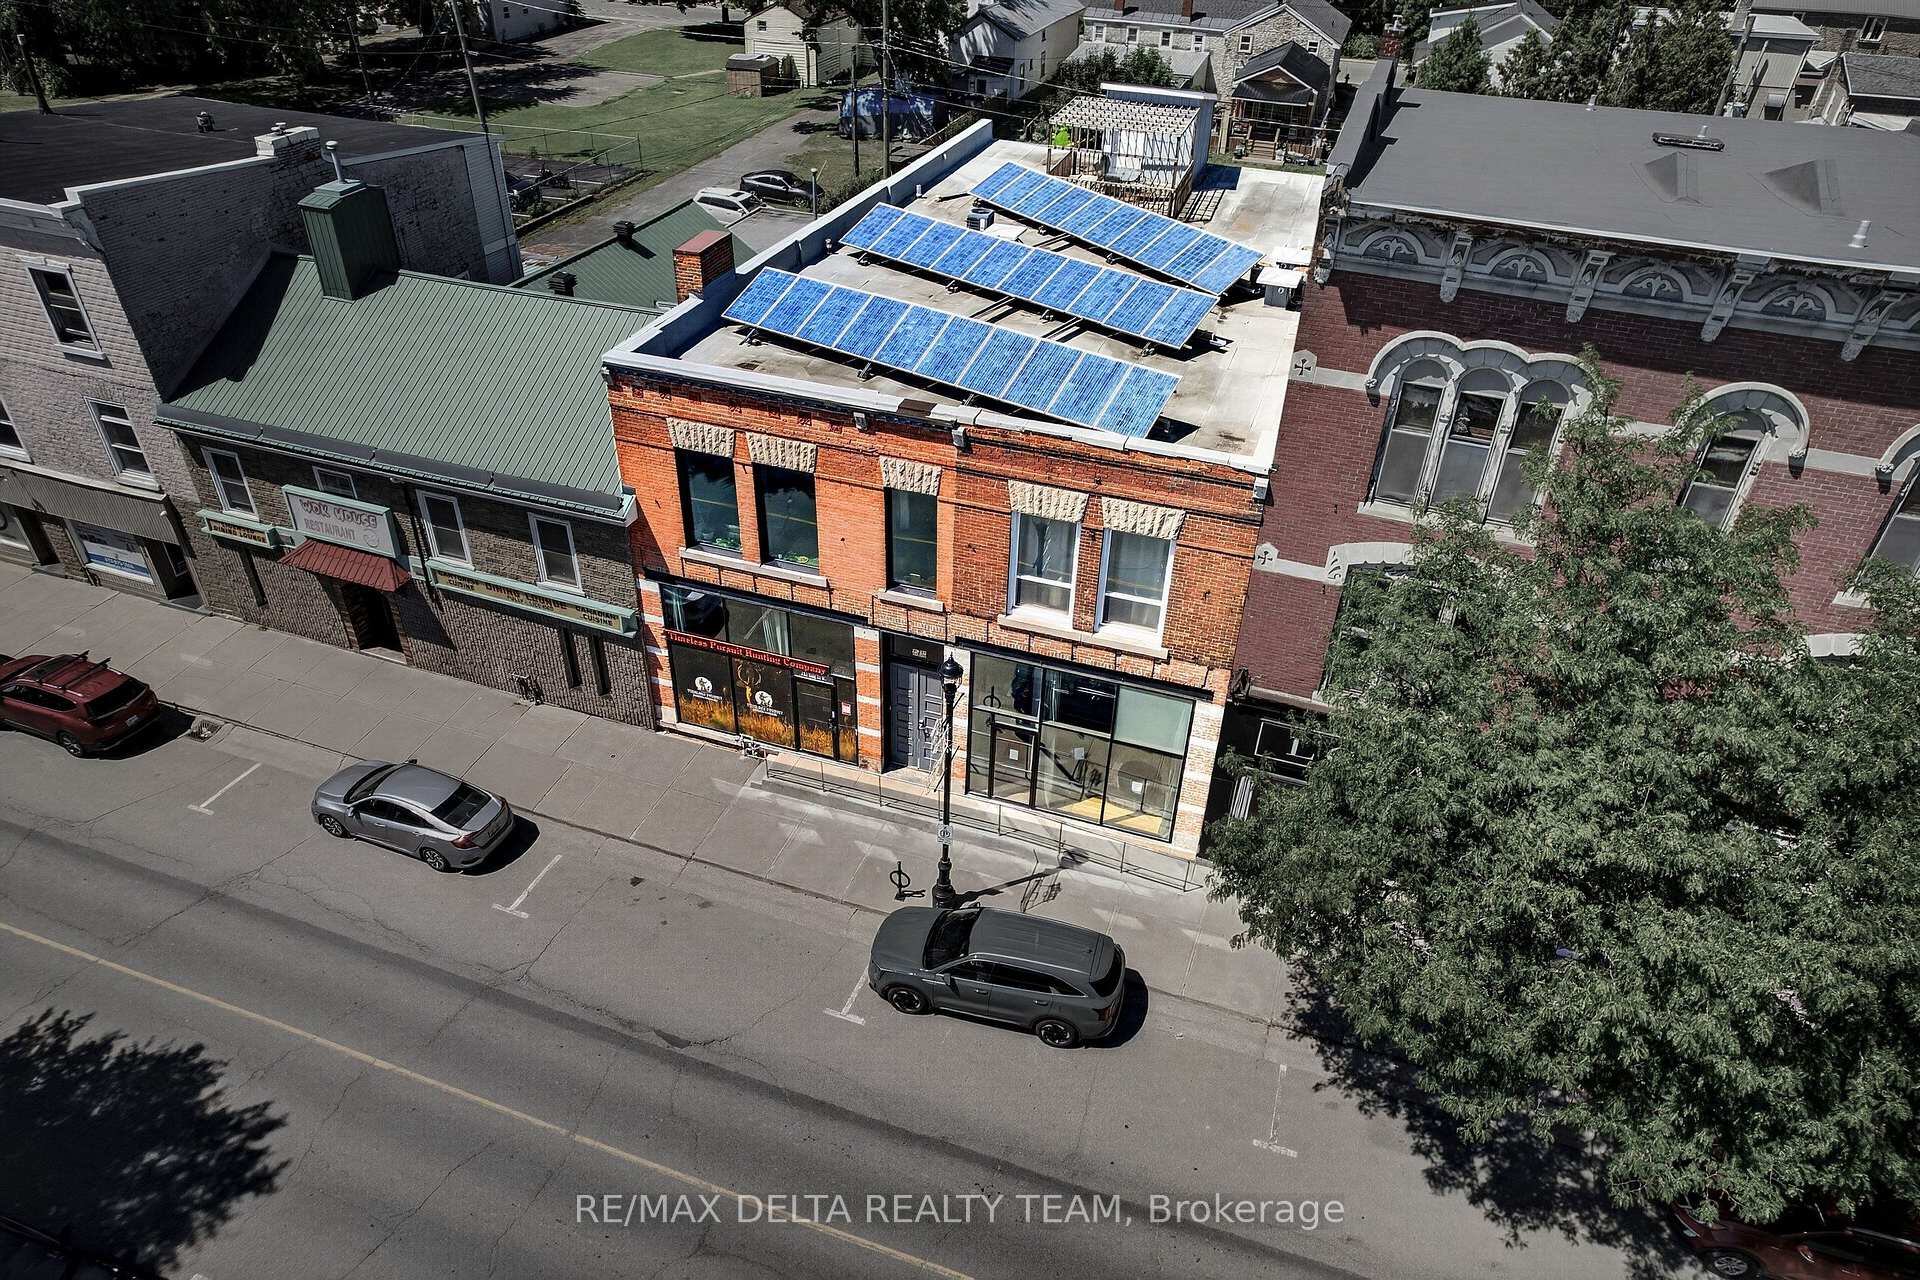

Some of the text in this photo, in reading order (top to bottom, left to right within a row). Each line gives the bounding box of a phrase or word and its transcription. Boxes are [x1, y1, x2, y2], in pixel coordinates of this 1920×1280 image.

[299, 499, 378, 528] WOK HOUSE
[304, 518, 356, 540] RESTAURANT
[667, 631, 708, 648] Timeless
[709, 641, 743, 656] Pursuit
[745, 649, 781, 665] Hunting
[783, 658, 827, 675] Company
